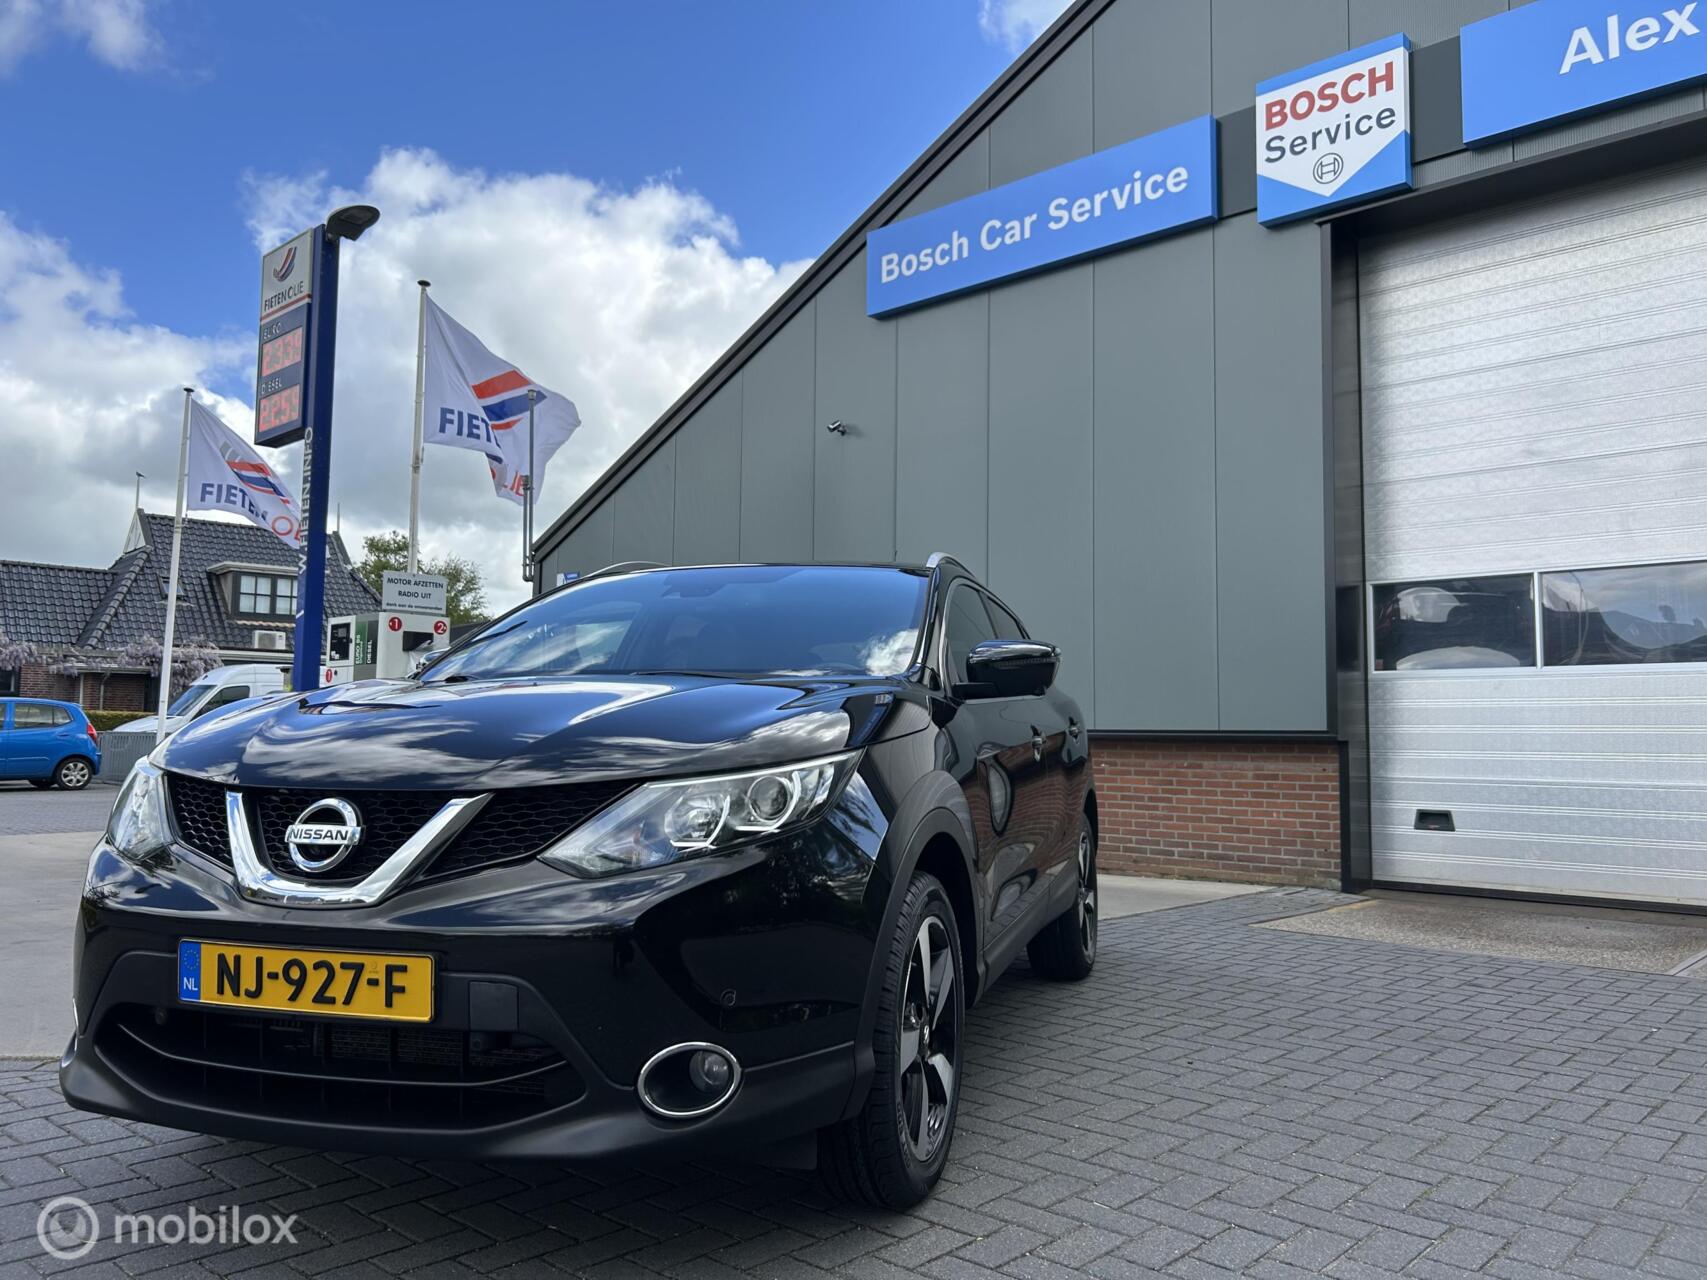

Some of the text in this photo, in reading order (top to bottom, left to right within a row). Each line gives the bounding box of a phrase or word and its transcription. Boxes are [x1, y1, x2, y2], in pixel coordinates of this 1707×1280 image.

[1559, 2, 1700, 75] Alex
[1265, 61, 1394, 131] BOSCH
[1264, 107, 1396, 164] Service
[881, 166, 1189, 284] Bosch Car Service
[387, 577, 444, 589] MOTOR AFZETTEN
[398, 590, 419, 598] RADIO
[289, 828, 349, 841] NISSAN
[183, 952, 408, 1008] NL NJ-927-F
